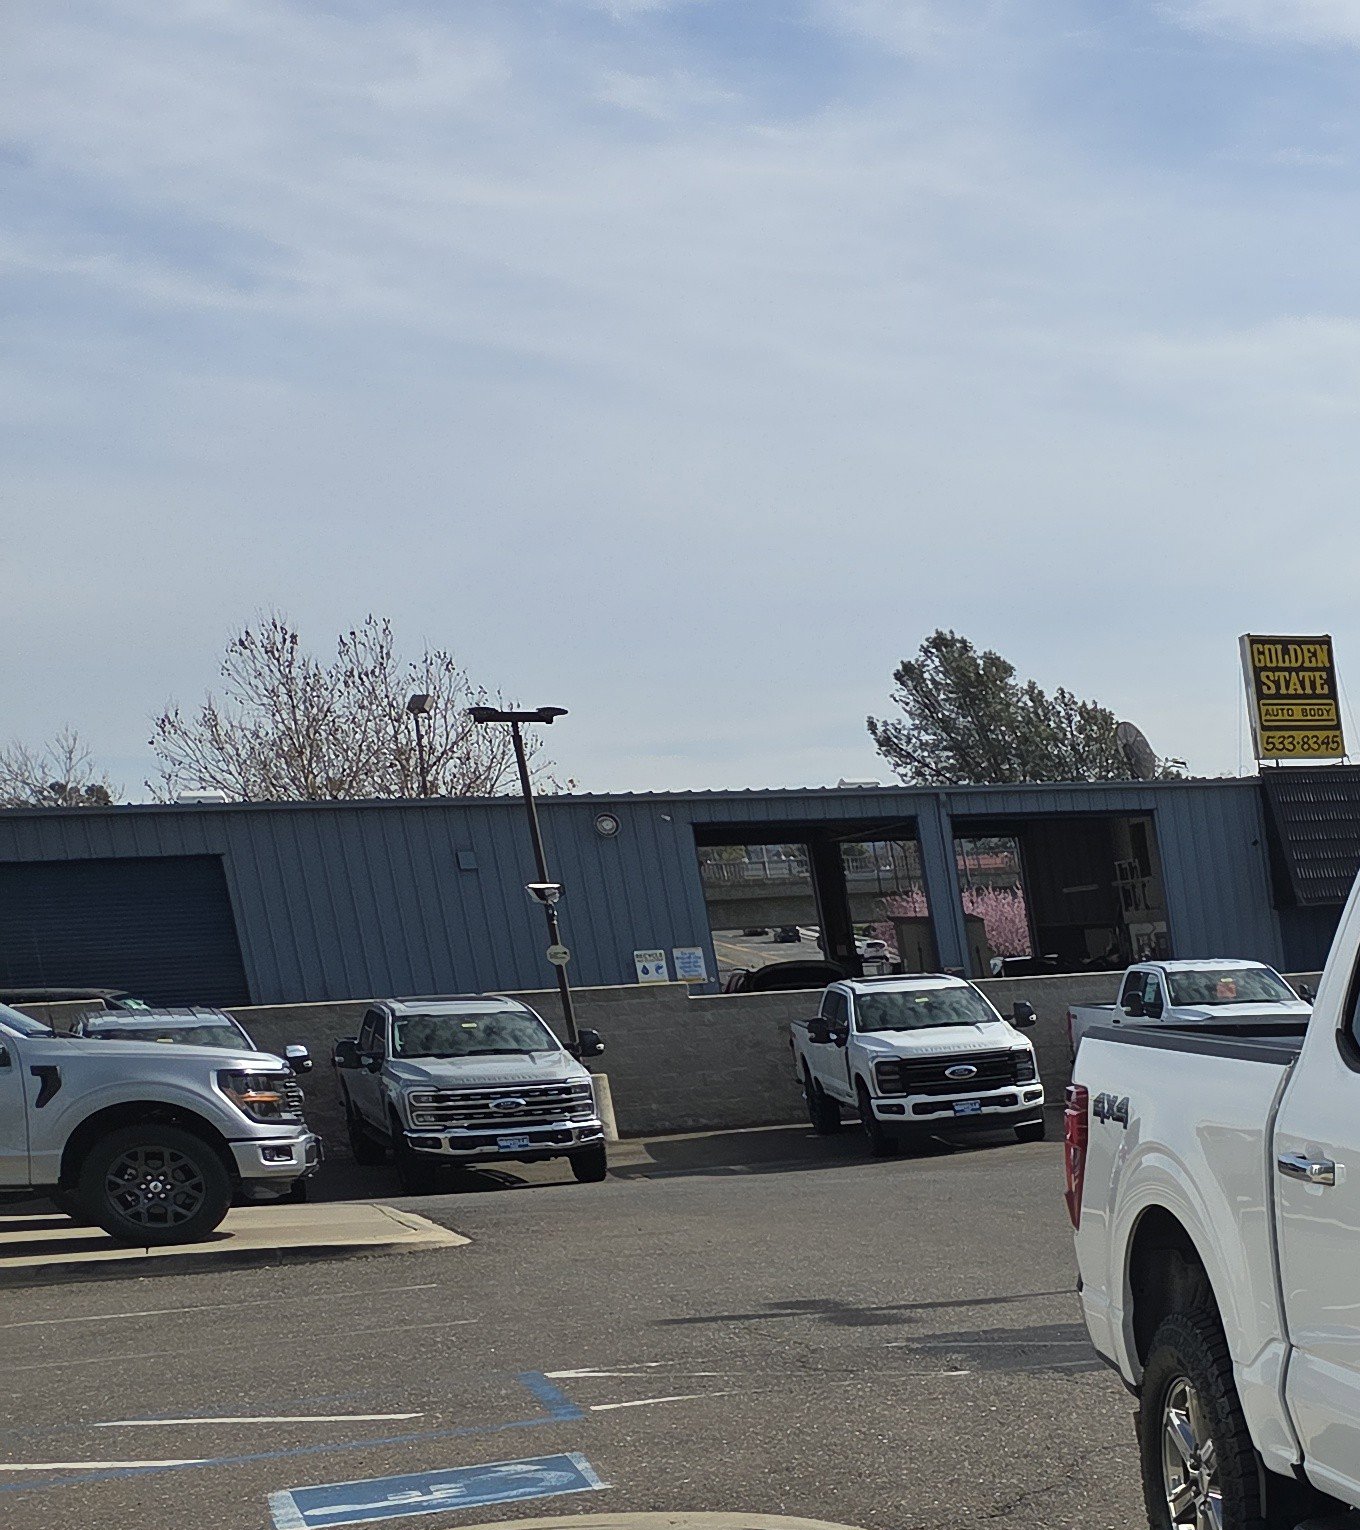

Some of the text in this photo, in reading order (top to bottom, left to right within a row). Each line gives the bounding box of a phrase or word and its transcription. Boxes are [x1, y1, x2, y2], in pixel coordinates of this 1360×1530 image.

[1252, 643, 1330, 668] GOLDEN
[1260, 671, 1329, 695] STATE
[1264, 707, 1332, 717] AUTO BODY
